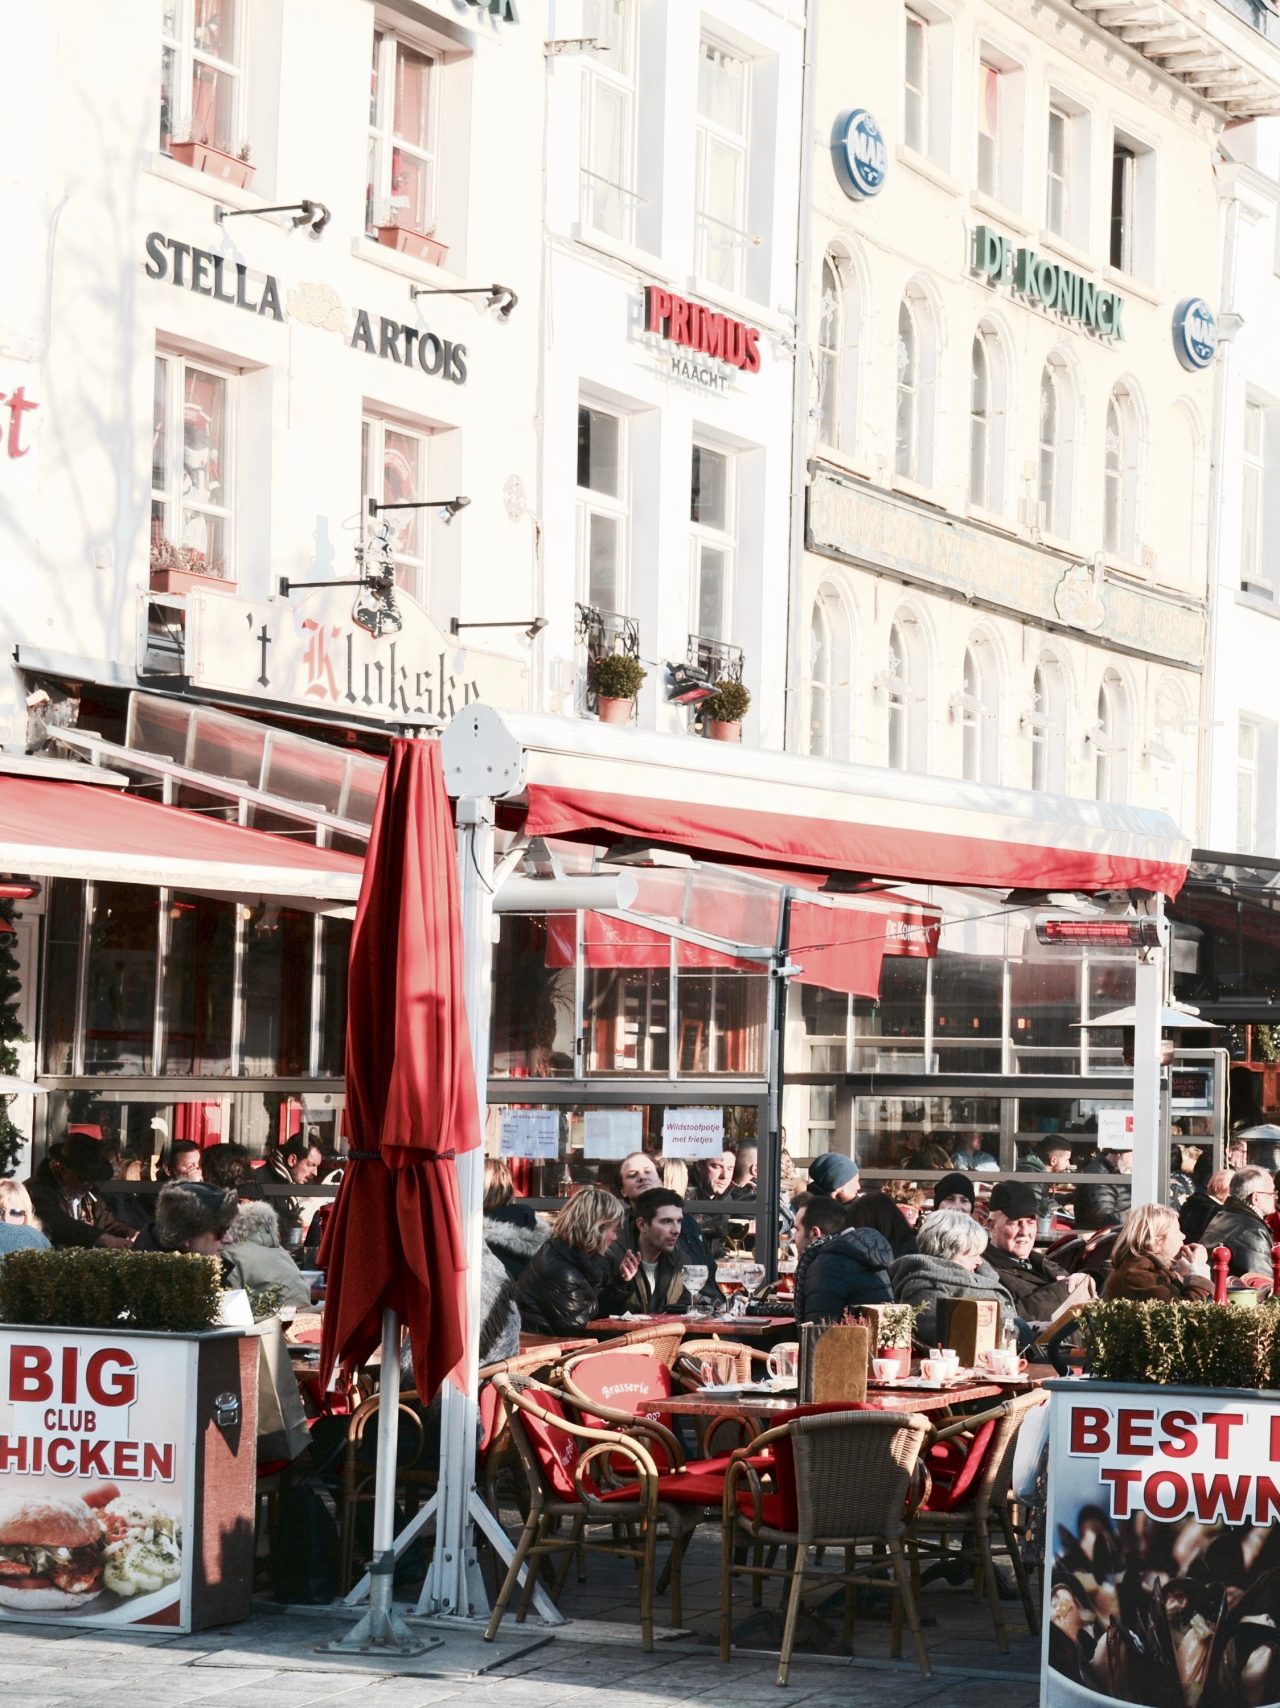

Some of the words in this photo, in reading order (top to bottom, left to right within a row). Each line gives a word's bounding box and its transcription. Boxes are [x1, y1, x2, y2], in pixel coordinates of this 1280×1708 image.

[976, 226, 1013, 285] DE
[1017, 248, 1124, 340] KONINCK
[145, 231, 284, 322] STELLA
[351, 308, 468, 385] ARTOIS
[644, 285, 760, 373] PRIMUS
[671, 357, 727, 392] HAACHT
[303, 618, 481, 721] Klokske
[666, 1122, 720, 1132] Wildstoofpotje
[672, 1135, 686, 1143] met
[688, 1134, 713, 1144] frietjes
[9, 1344, 135, 1407] BIG
[602, 1382, 649, 1398] Brasserie
[44, 1408, 96, 1432] CLUB
[1070, 1407, 1244, 1459] BEST
[0, 1434, 173, 1479] HICKEN
